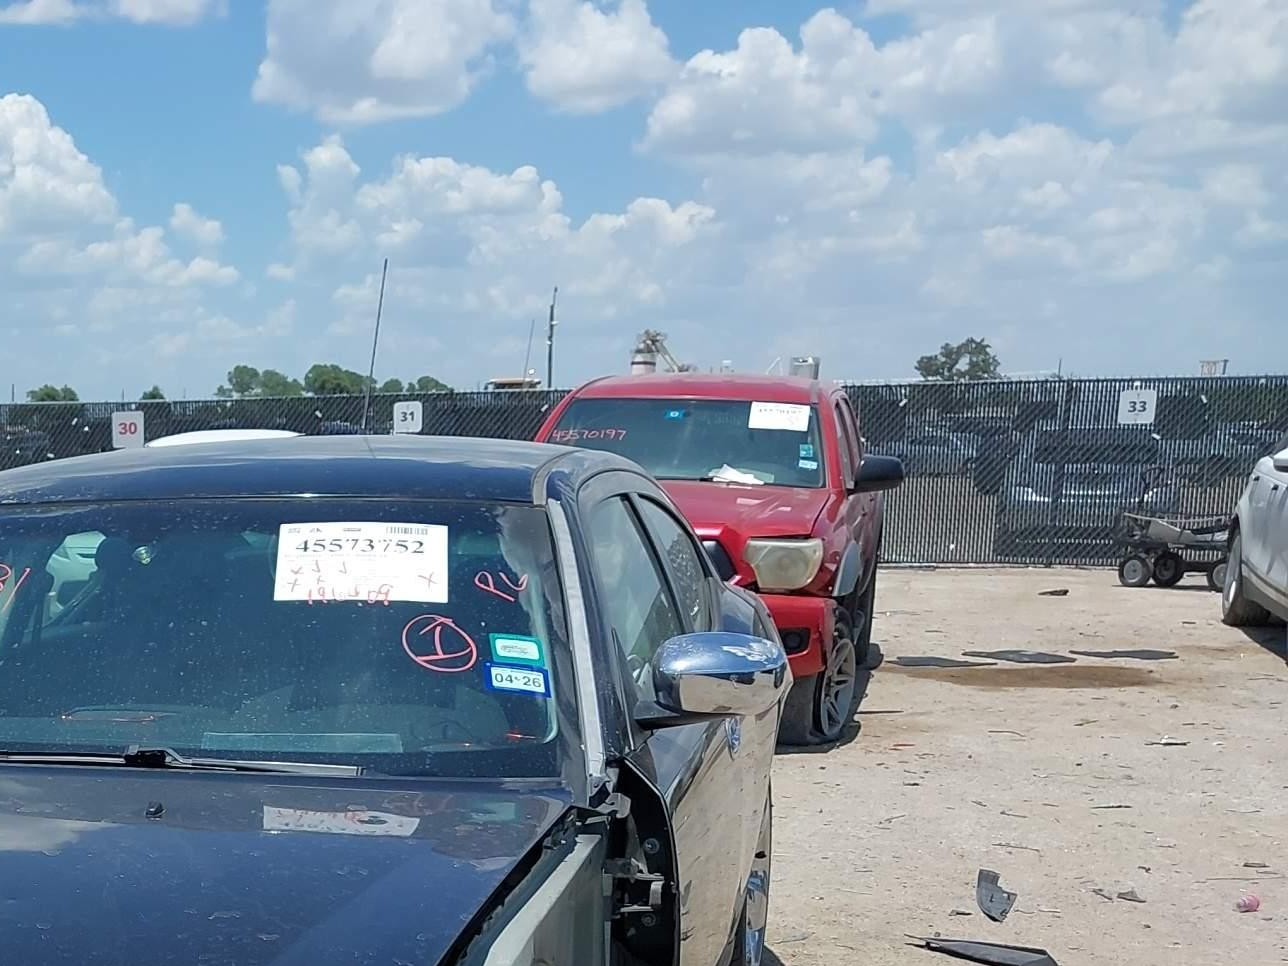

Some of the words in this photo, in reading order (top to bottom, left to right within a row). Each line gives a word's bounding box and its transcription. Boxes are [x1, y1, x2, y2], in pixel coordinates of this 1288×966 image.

[1127, 400, 1148, 413] 33
[400, 410, 415, 422] 31
[118, 421, 138, 436] 30
[552, 428, 627, 441] 45570197
[295, 538, 425, 554] 45573752
